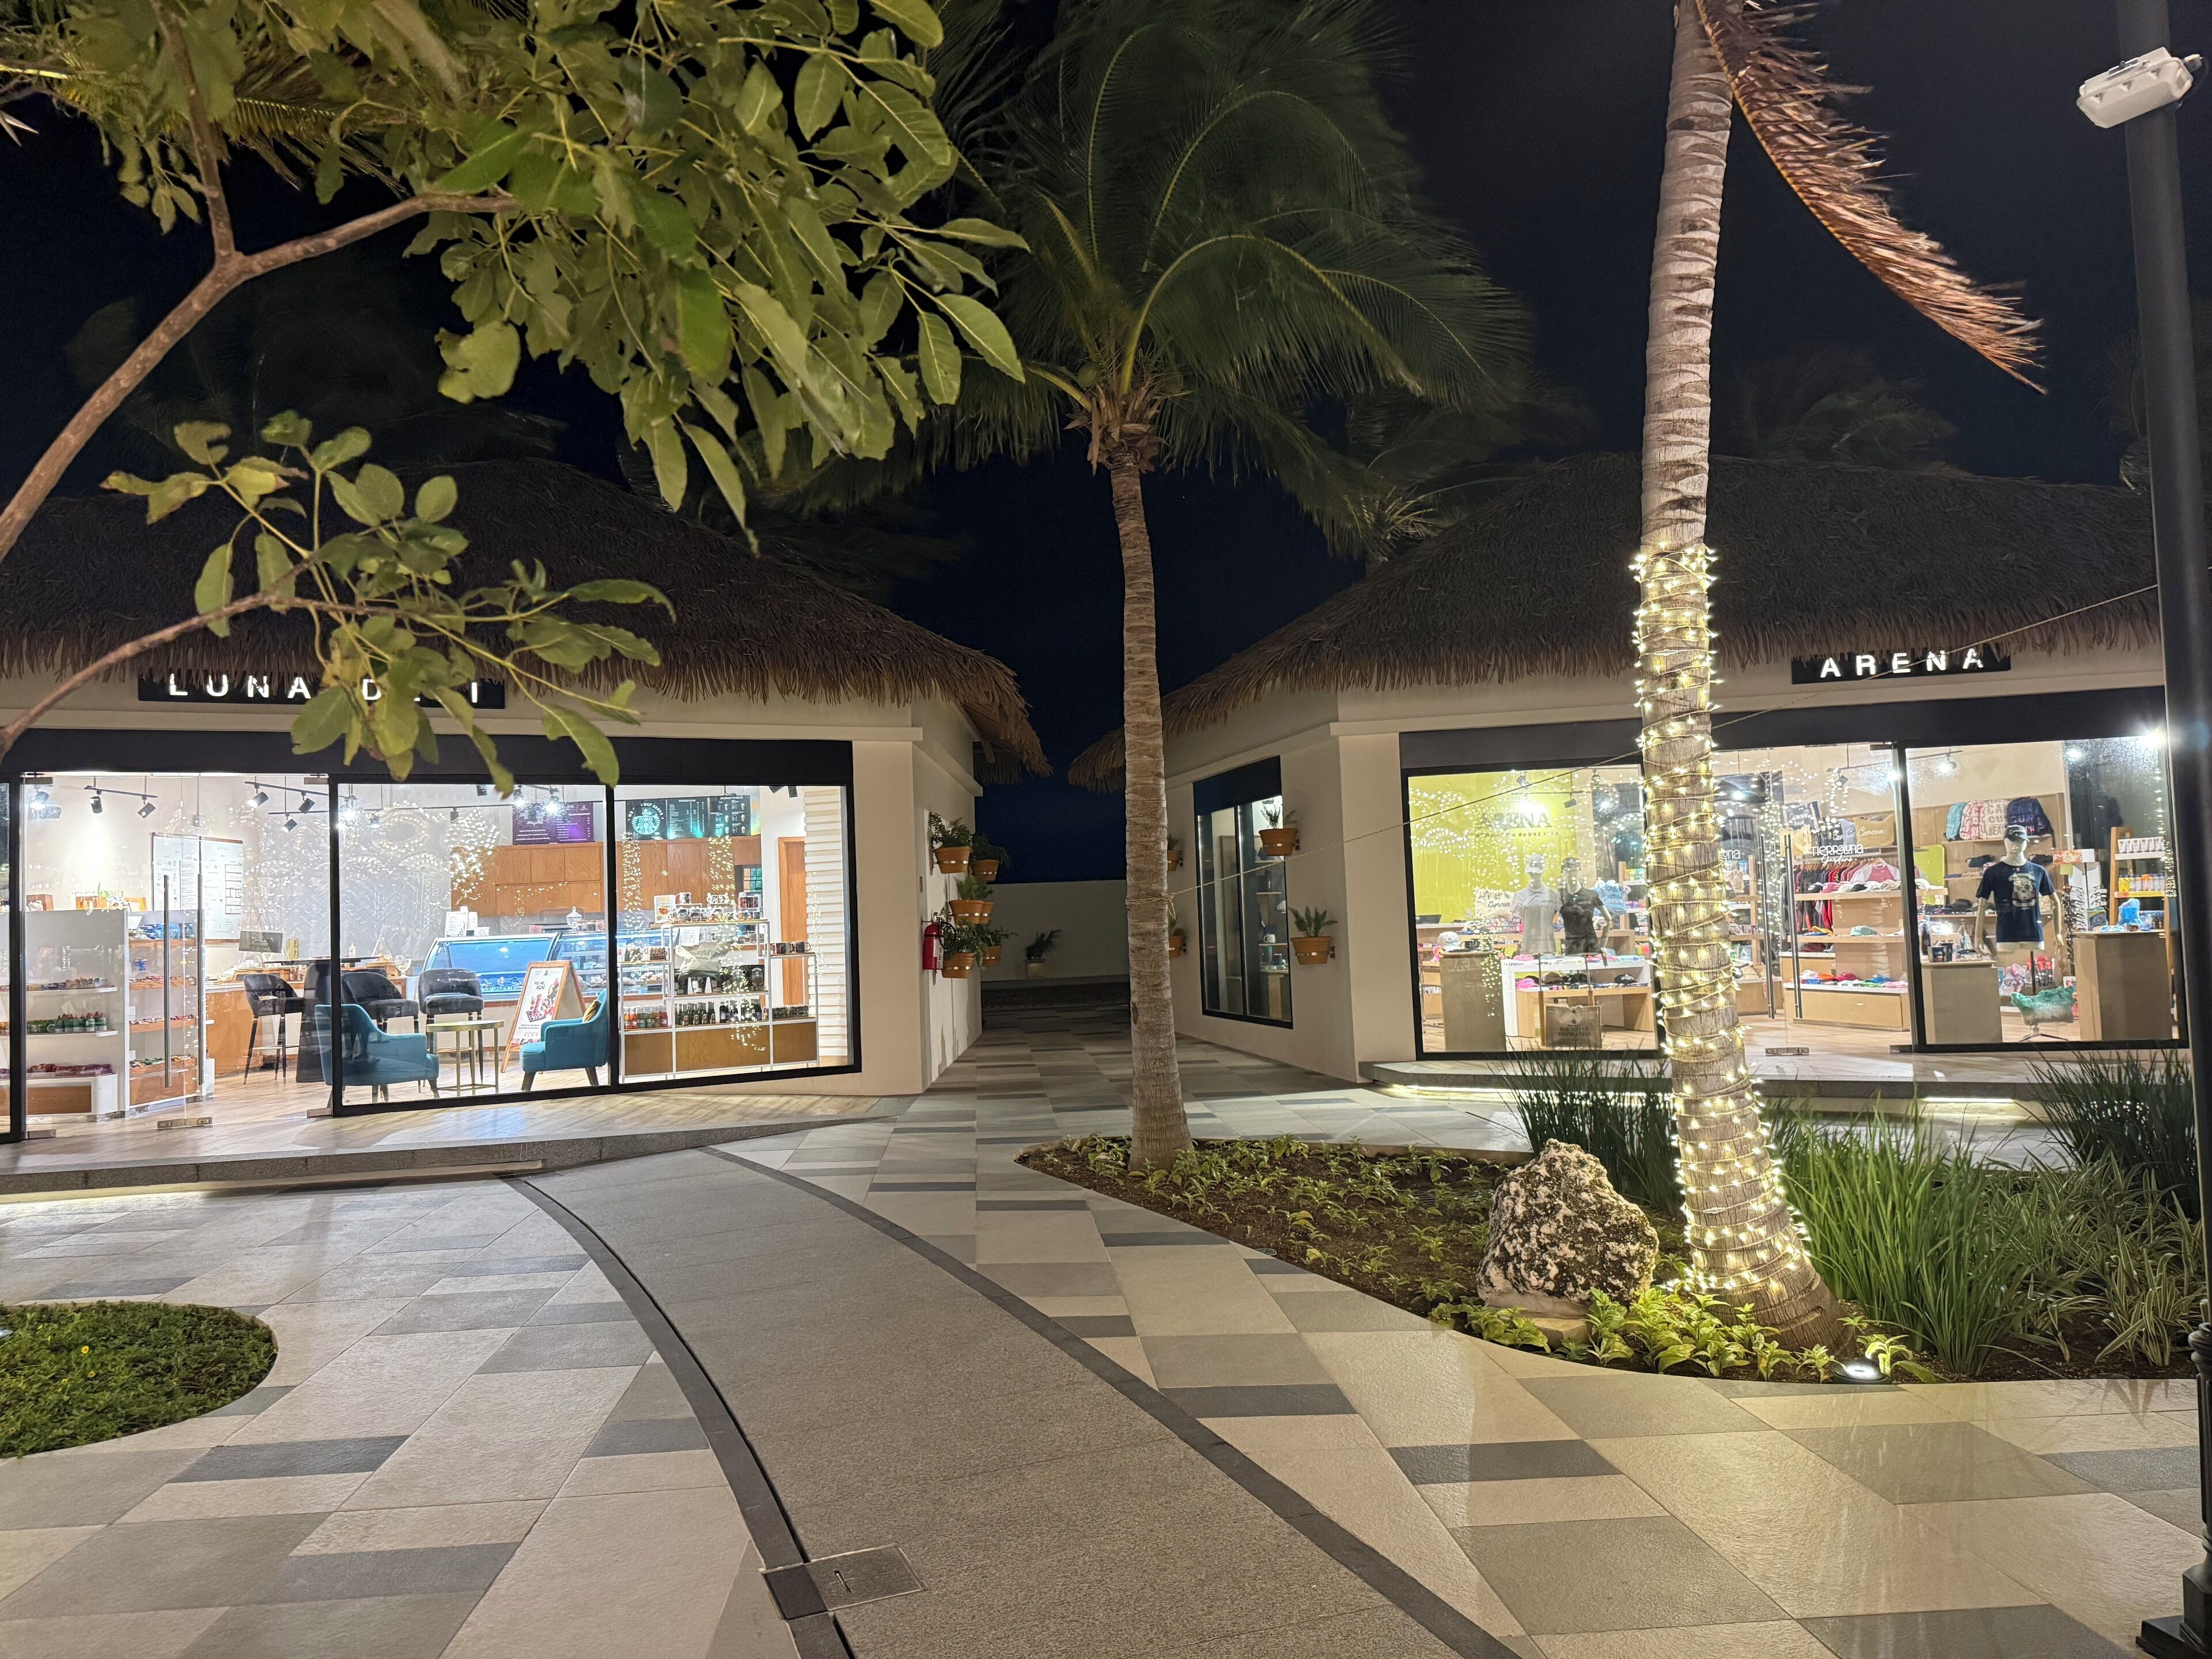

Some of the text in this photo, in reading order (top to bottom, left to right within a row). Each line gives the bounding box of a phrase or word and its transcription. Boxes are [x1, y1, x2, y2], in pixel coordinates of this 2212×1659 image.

[1820, 648, 1984, 679] ARENA
[169, 673, 478, 703] LUNA DI
